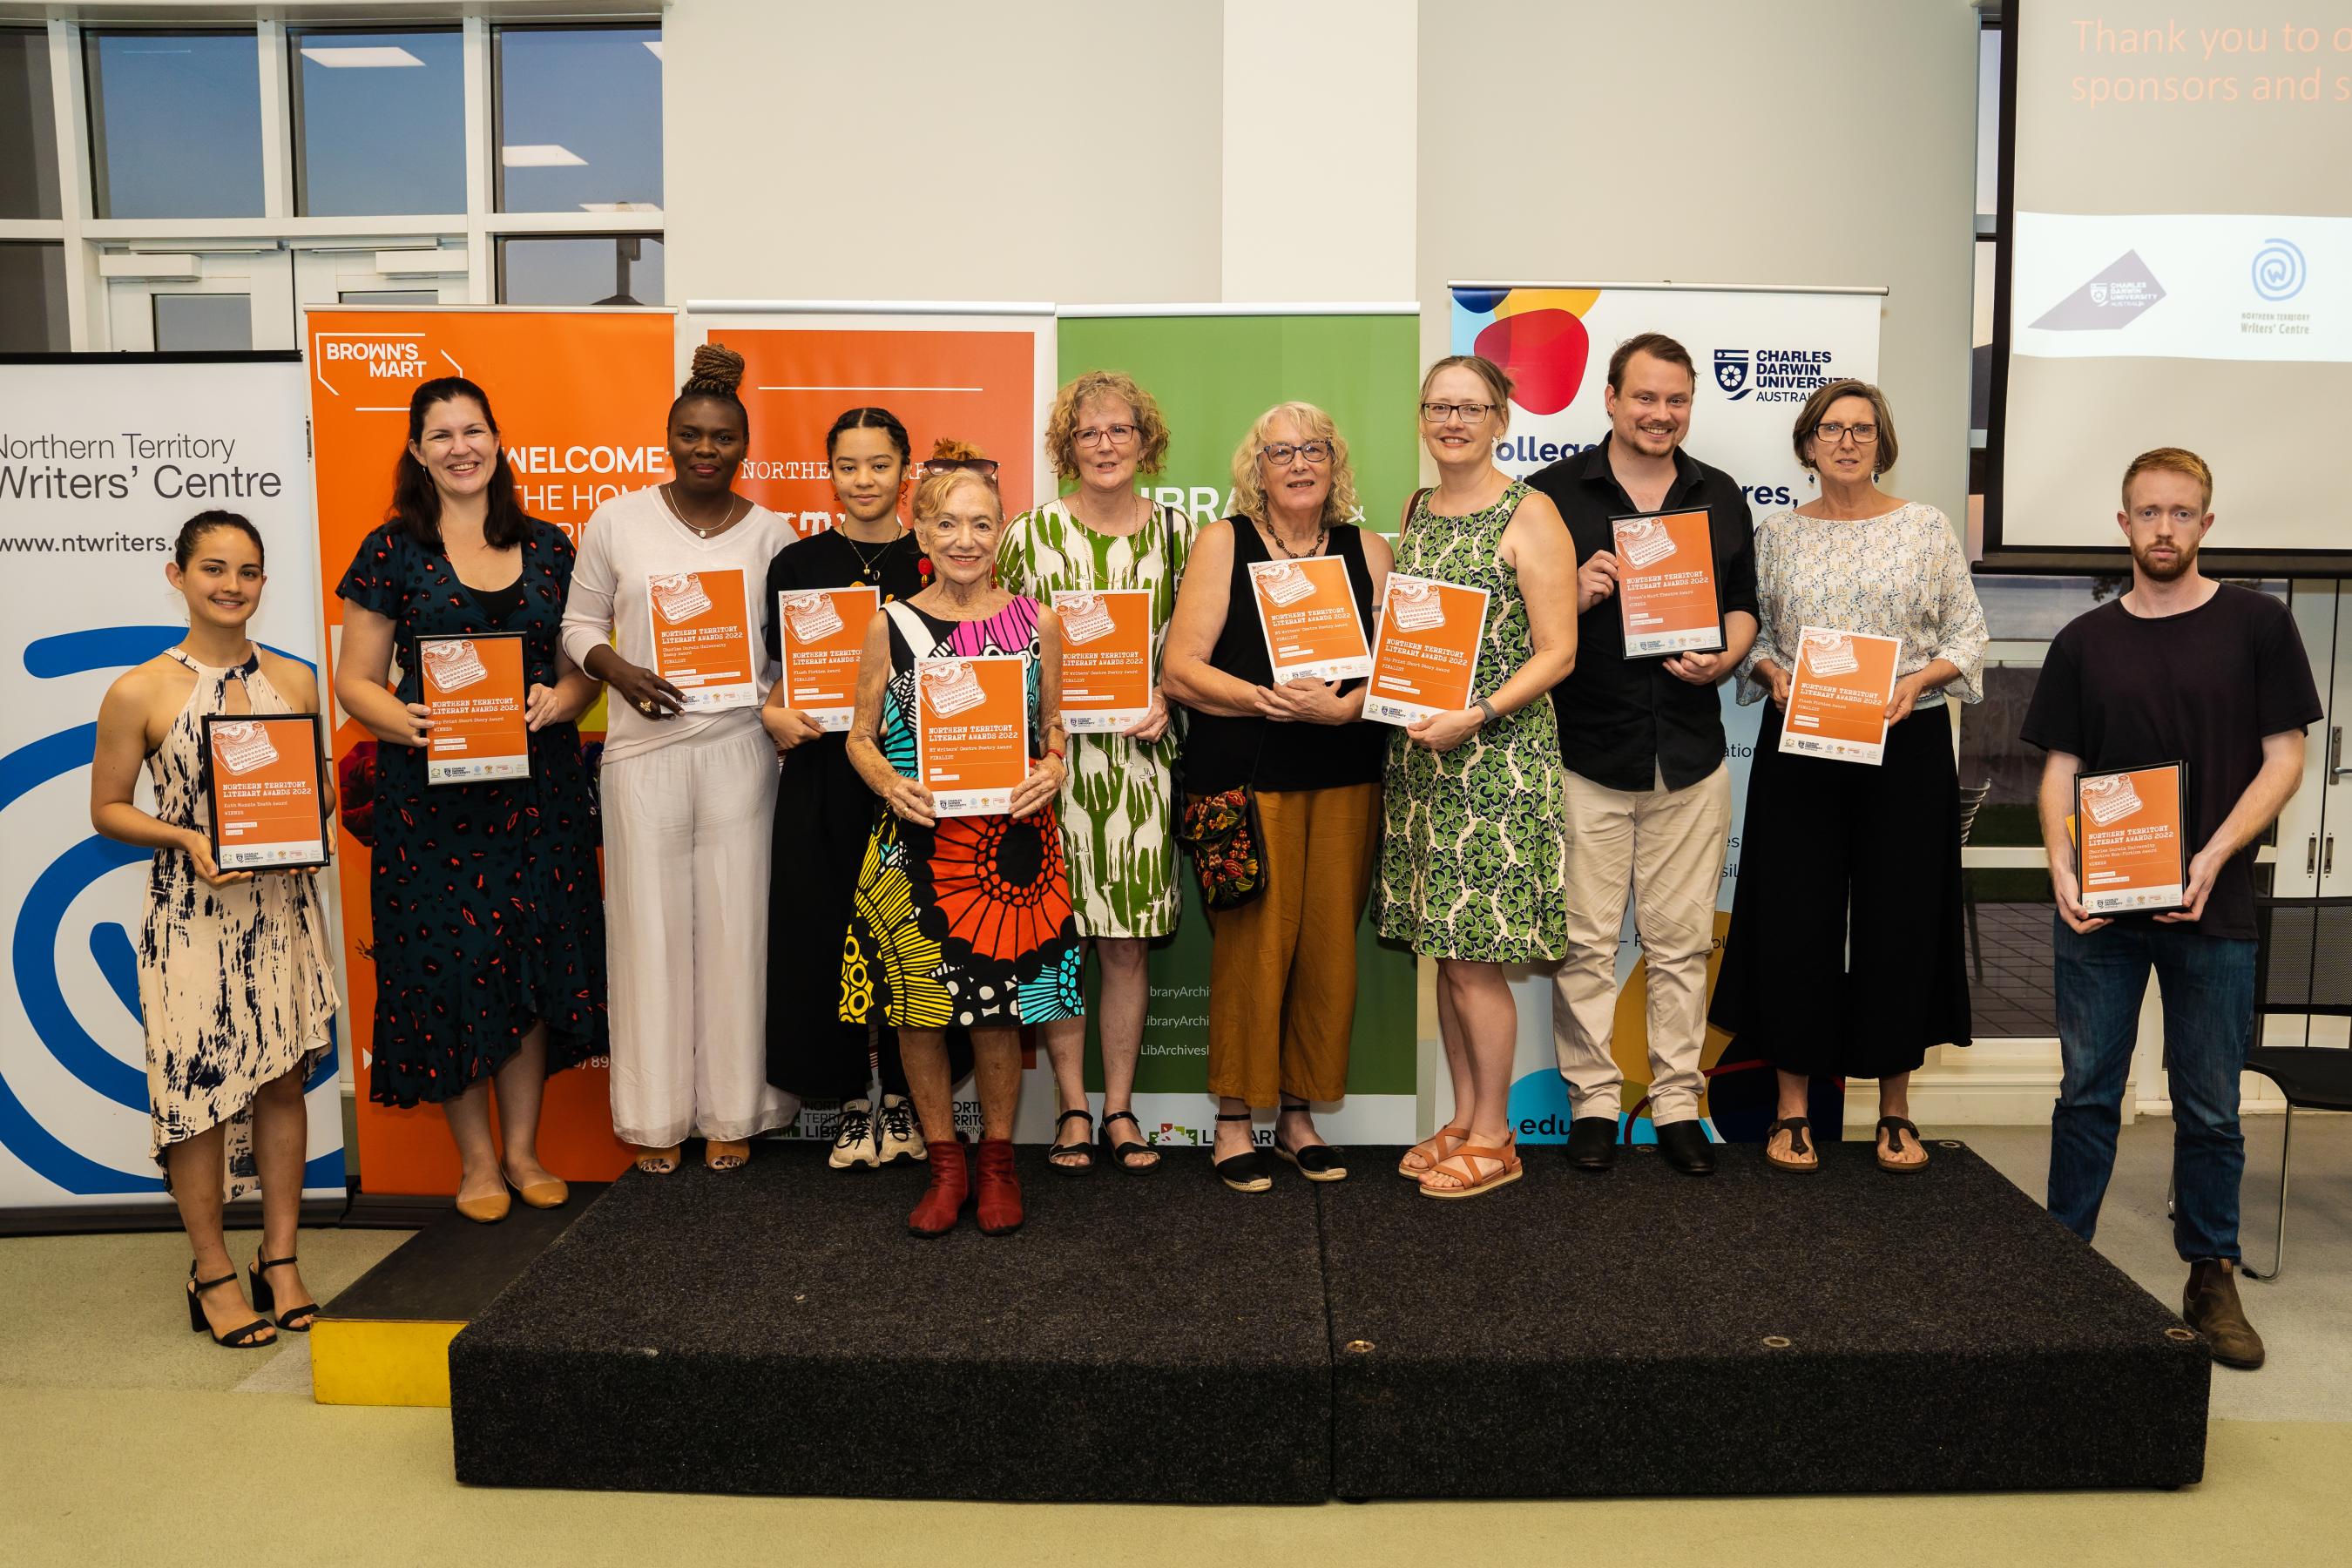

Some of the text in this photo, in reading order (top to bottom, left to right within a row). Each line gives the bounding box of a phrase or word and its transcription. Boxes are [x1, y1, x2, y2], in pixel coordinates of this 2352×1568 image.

[2072, 18, 2186, 54] Thank
[2200, 26, 2266, 60] you
[2281, 23, 2320, 53] to
[2071, 75, 2239, 109] sponsors
[2252, 67, 2322, 101] and
[2279, 323, 2309, 335] Centre
[327, 343, 418, 360] BROWN'S
[1756, 350, 1832, 362] CHARLES
[369, 362, 427, 377] MART
[1757, 363, 1821, 375] DARWIN
[122, 433, 235, 463] Territory
[154, 464, 281, 498] Centre
[1273, 618, 1306, 626] LITERARY
[1385, 645, 1468, 666] LITERARY AWARDS 2022
[1386, 638, 1464, 658] NORTHERN TERRITORY
[1800, 689, 1835, 699] LITERARY
[1836, 695, 1862, 704] AWARDS
[1801, 683, 1878, 699] NORTHERN TERRITORY
[929, 733, 965, 742] LITERARY
[2089, 825, 2168, 840] NORTHERN TERRITORY
[2089, 837, 2124, 847] LITERARY
[1150, 986, 1211, 999] braryArchi
